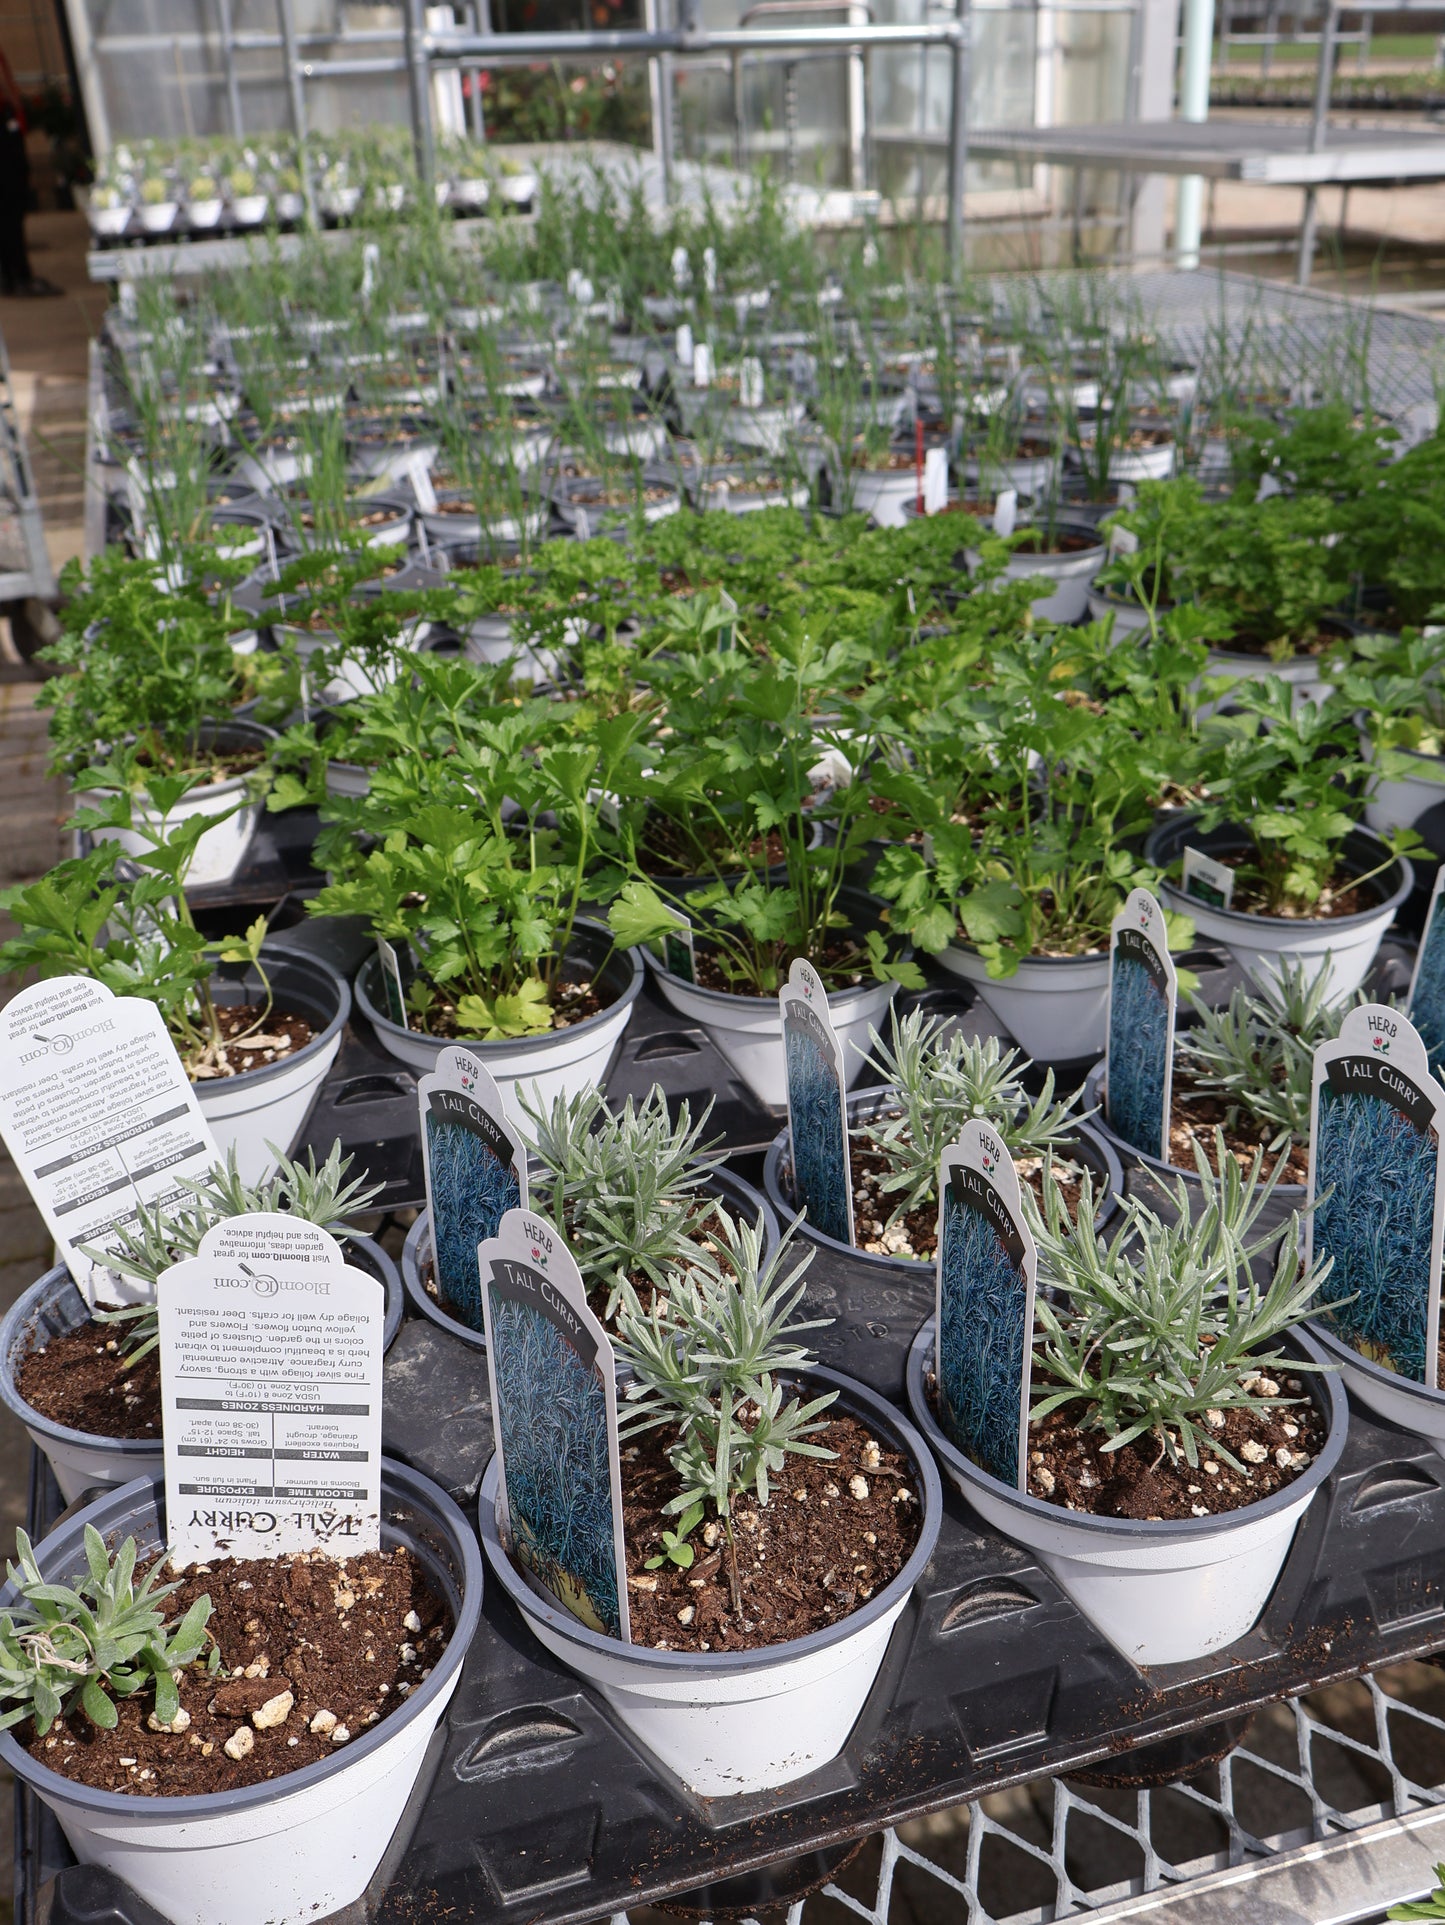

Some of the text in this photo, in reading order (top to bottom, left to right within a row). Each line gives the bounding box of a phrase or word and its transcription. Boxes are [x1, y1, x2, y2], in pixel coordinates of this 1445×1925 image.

[72, 982, 87, 992] tips
[58, 988, 72, 999] and
[69, 988, 94, 1003] garden
[33, 994, 59, 1009] helpful
[87, 996, 103, 1007] Visit
[792, 1003, 807, 1020] TALL
[8, 1008, 48, 1028] informative
[28, 1023, 38, 1031] for
[1368, 1016, 1397, 1037] HERB
[7, 1026, 27, 1040] great
[129, 1030, 156, 1045] foliage
[115, 1042, 128, 1052] dry
[124, 1043, 149, 1060] yellow
[85, 1056, 97, 1065] for
[97, 1049, 114, 1061] well
[97, 1056, 124, 1071] button
[455, 1056, 478, 1079] HERB
[38, 1072, 59, 1086] Deer
[147, 1070, 167, 1082] curry
[155, 1078, 173, 1089] Fine
[1340, 1060, 1420, 1105] TALL CURRY
[0, 1081, 36, 1101] resistant
[31, 1081, 65, 1098] Flowers
[134, 1086, 154, 1100] silver
[14, 1095, 31, 1107] and
[68, 1096, 105, 1116] Attractive
[106, 1096, 133, 1111] foliage
[88, 1108, 106, 1119] with
[439, 1094, 501, 1143] TALL CURRY
[22, 1113, 67, 1138] ornamental
[25, 1131, 52, 1147] savory
[71, 1119, 154, 1161] HARDINESS ZONES
[979, 1132, 1000, 1162] HERB
[152, 1152, 184, 1170] WATER
[76, 1185, 110, 1206] HEIGHT
[960, 1169, 1015, 1237] TALL CURRY
[223, 1229, 319, 1241] tips and helpful advice.
[523, 1222, 553, 1253] HERB
[219, 1239, 324, 1251] garden ideas, informative
[213, 1249, 330, 1263] Visit BloomIQ.com for great
[504, 1264, 582, 1335] TALL CURRY
[174, 1307, 369, 1323] foliage dry well for crafts. Deer resistant.
[188, 1320, 355, 1334] yellow button flowers. Flowers and
[180, 1330, 364, 1345] colors in the garden. Clusters of petite
[174, 1342, 207, 1351] vibrant
[222, 1344, 281, 1353] complement
[284, 1347, 325, 1356] beautiful
[347, 1349, 369, 1358] herb
[182, 1354, 362, 1368] curry fragrance. Attractive ornamental
[179, 1363, 211, 1372] savory
[214, 1365, 247, 1375] strong,
[281, 1368, 313, 1378] foliage
[316, 1371, 341, 1379] silver
[343, 1371, 365, 1380] Fine
[226, 1380, 254, 1389] (30°F).
[270, 1383, 291, 1391] Zone
[235, 1389, 261, 1398] (10°F)
[221, 1401, 324, 1412] HARDINESS ZONES
[214, 1419, 230, 1427] cm)
[232, 1421, 259, 1429] (30-38
[187, 1428, 214, 1436] 12-15"
[216, 1429, 243, 1437] Space
[286, 1430, 358, 1440] drainage, drought
[180, 1435, 196, 1443] cm)
[199, 1436, 212, 1444] (61
[240, 1438, 267, 1446] Grows
[322, 1440, 359, 1449] Requires
[204, 1447, 245, 1456] HEIGHT
[302, 1450, 340, 1459] WATER
[236, 1477, 257, 1485] Plant
[329, 1480, 360, 1488] Blooms
[196, 1485, 255, 1494] EXPOSURE
[287, 1488, 354, 1497] BLOOM TIME
[214, 1497, 333, 1508] Helichrysum italicum
[189, 1510, 359, 1536] TALL CURRY
